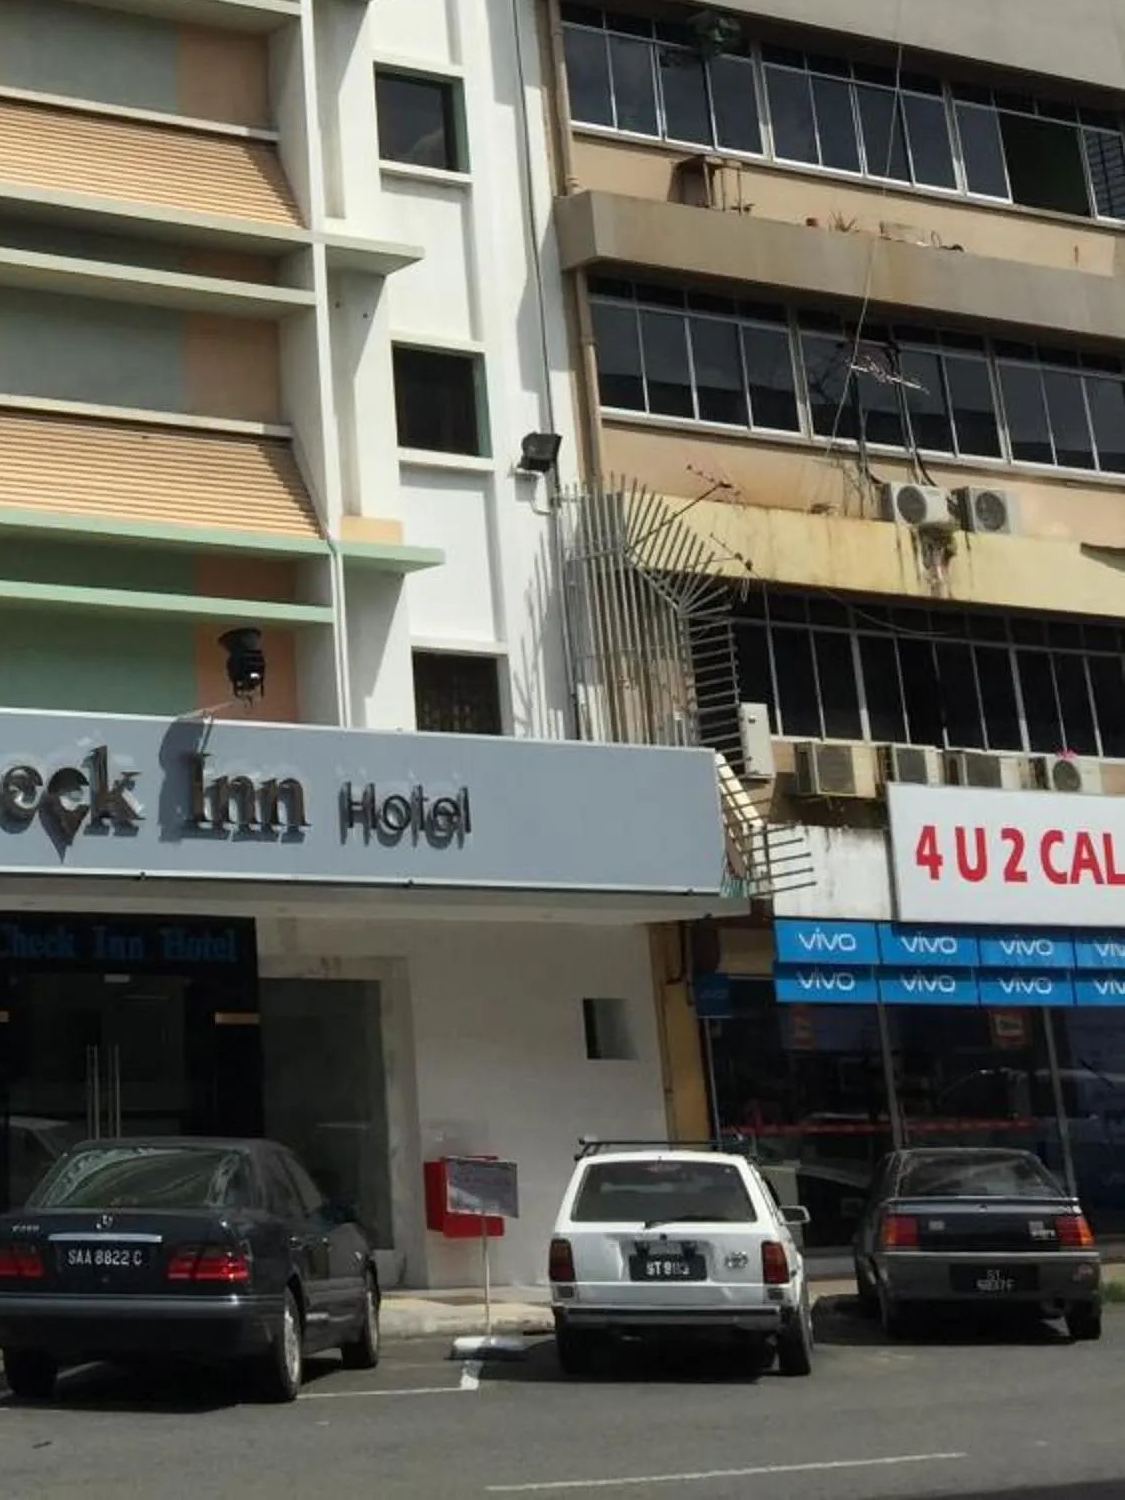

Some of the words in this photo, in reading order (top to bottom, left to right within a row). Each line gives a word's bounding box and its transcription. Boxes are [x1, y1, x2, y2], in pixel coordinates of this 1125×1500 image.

[181, 751, 311, 834] Inn
[340, 780, 472, 842] Hotel
[92, 925, 144, 961] Inn
[160, 926, 236, 963] Hotel
[68, 1249, 92, 1265] SAA
[94, 1249, 130, 1266] 8822
[133, 1250, 143, 1266] C
